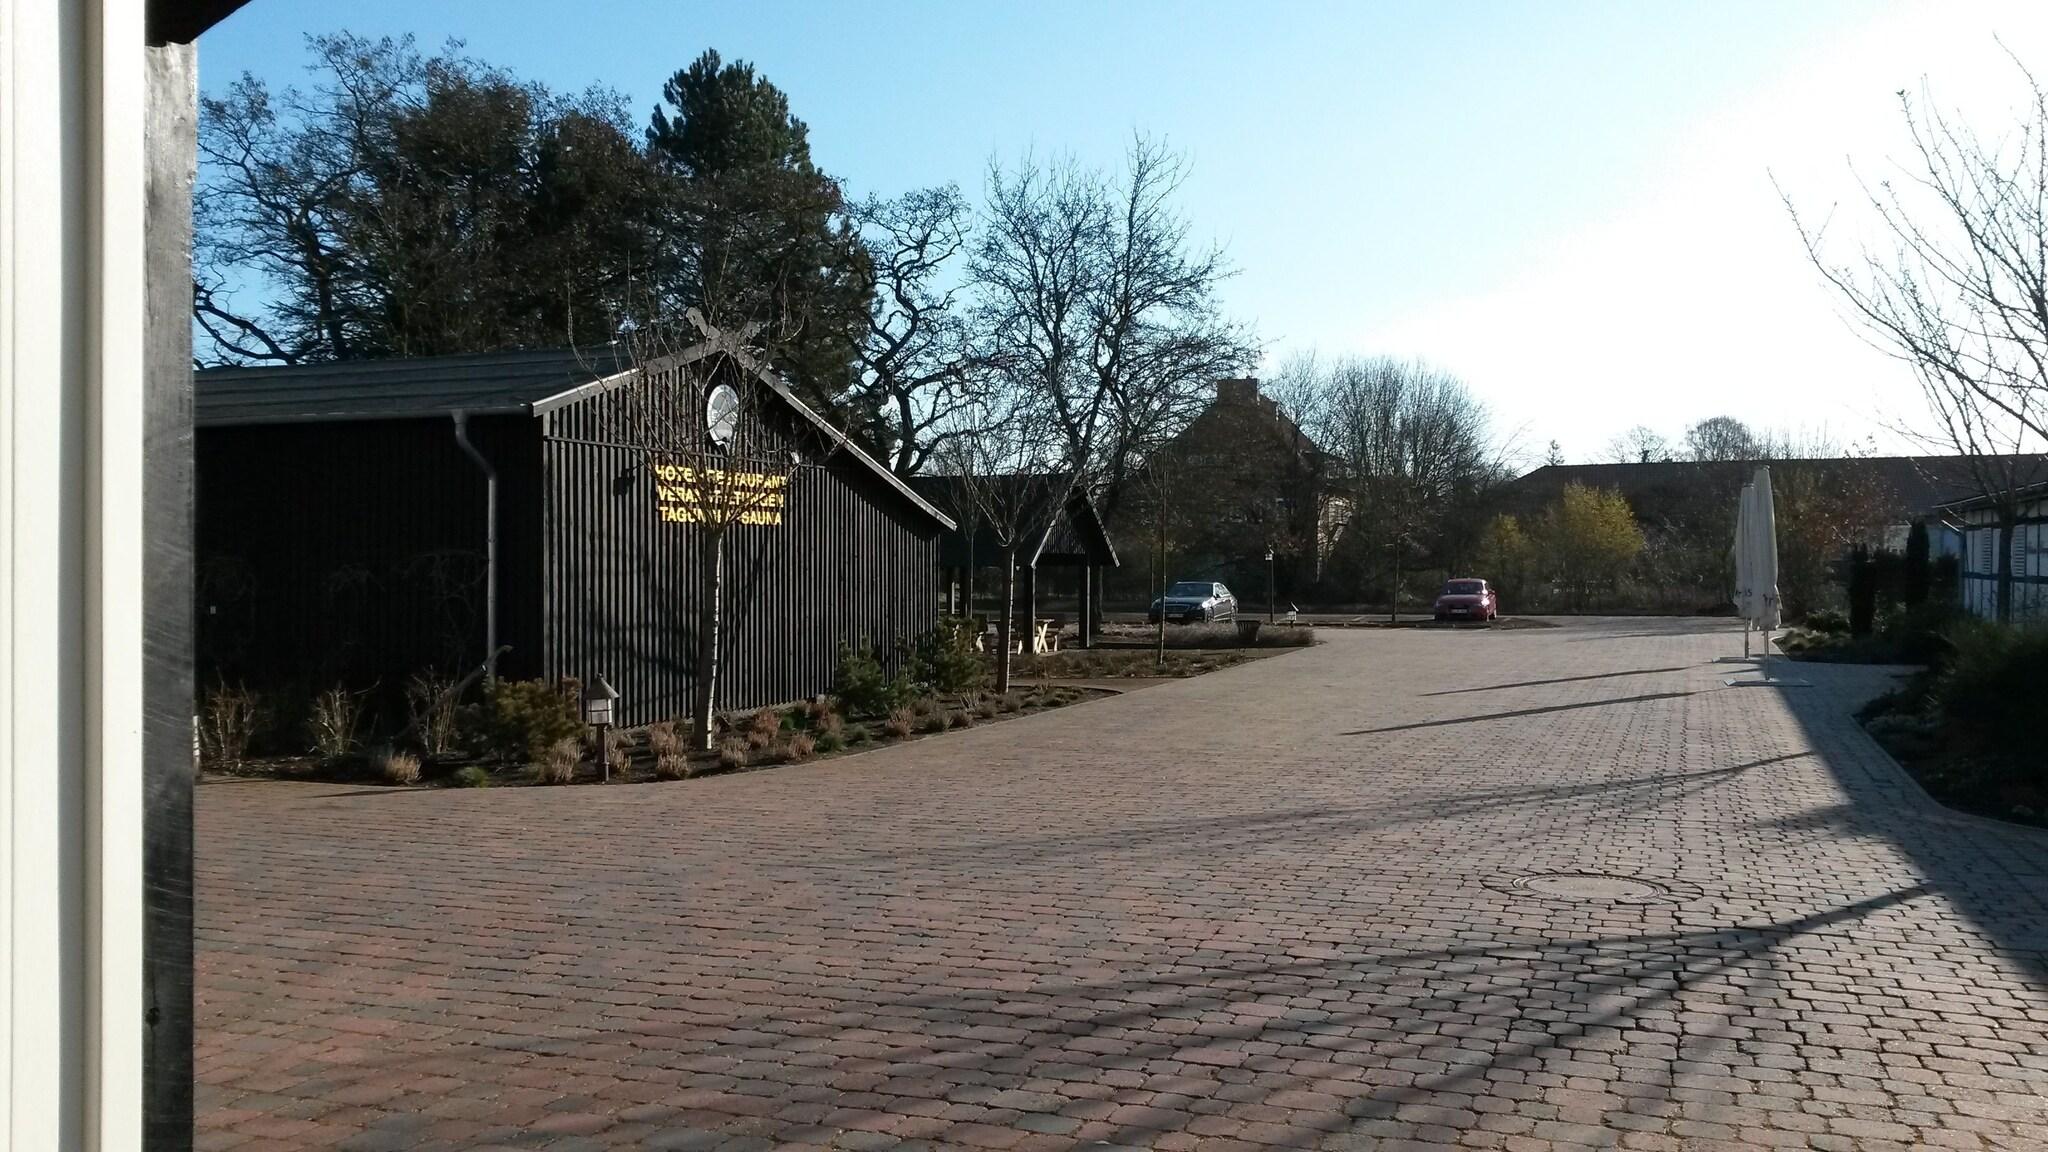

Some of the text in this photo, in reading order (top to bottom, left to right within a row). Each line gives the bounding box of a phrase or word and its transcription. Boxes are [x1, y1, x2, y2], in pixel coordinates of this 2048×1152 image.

[655, 464, 697, 483] HOTE
[657, 485, 784, 508] VERANTTUNGEN
[659, 506, 782, 525] TAGUN SAUNA
